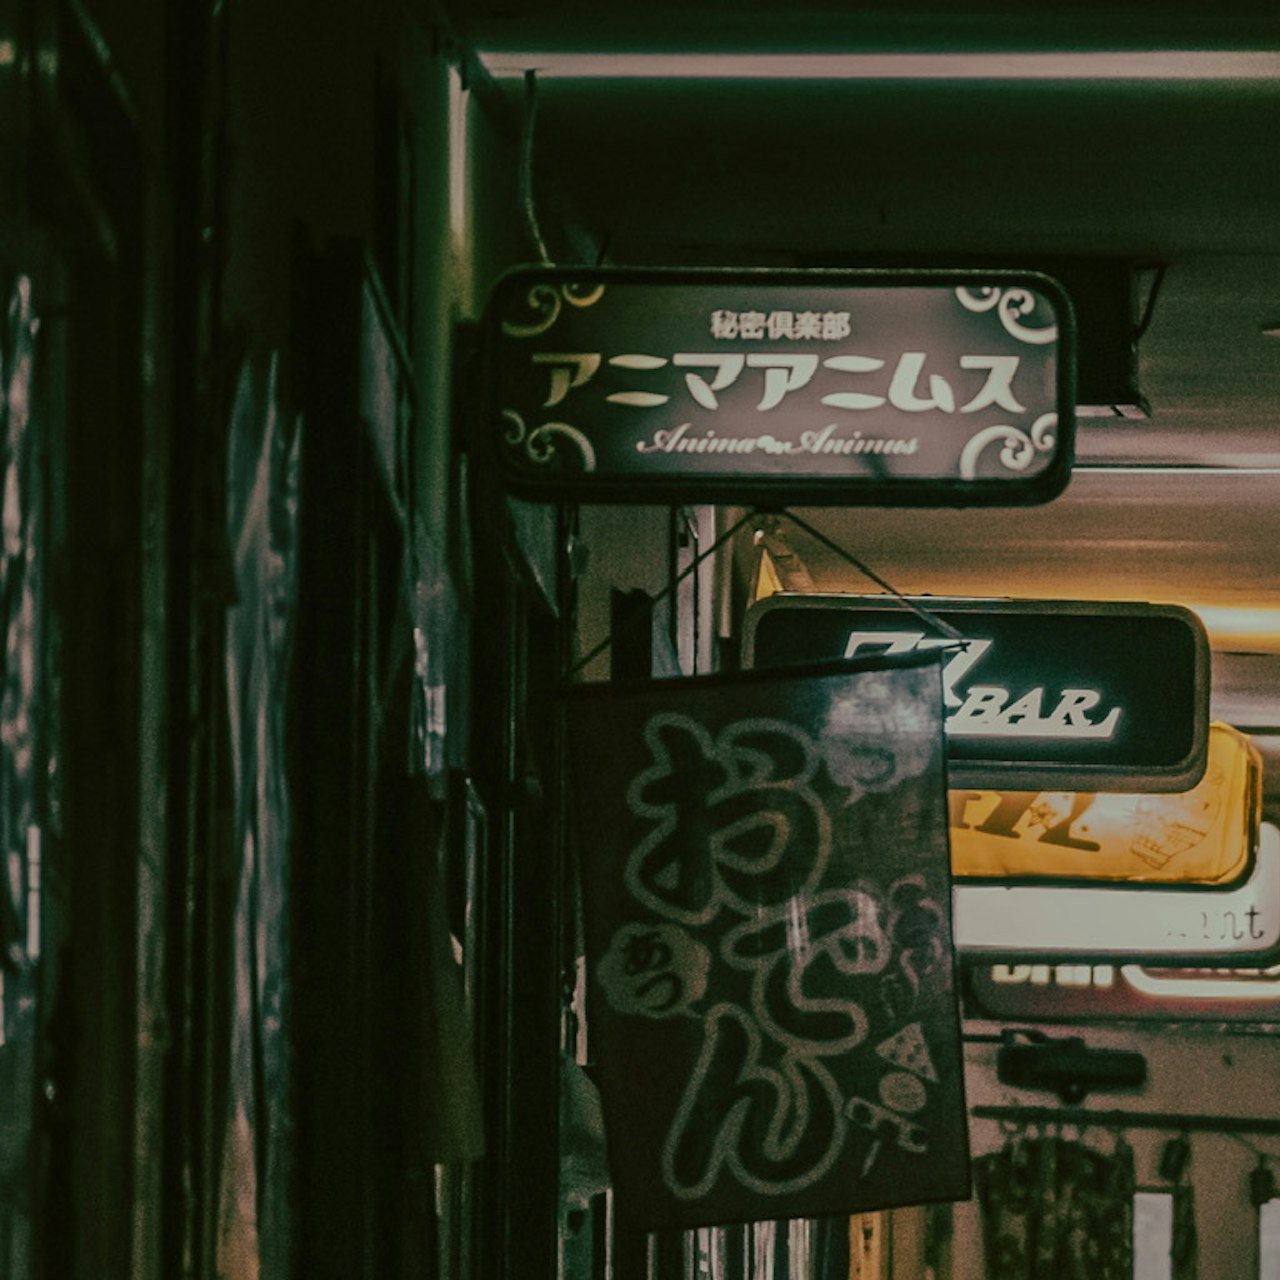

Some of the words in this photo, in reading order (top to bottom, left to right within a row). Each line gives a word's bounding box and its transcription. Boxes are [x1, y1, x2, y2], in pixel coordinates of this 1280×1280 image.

[711, 309, 851, 341] 秘密倶楽部
[530, 351, 1027, 414] アニマアニムス
[636, 421, 757, 455] Anima
[792, 422, 920, 456] Animus
[951, 685, 1101, 728] BAR
